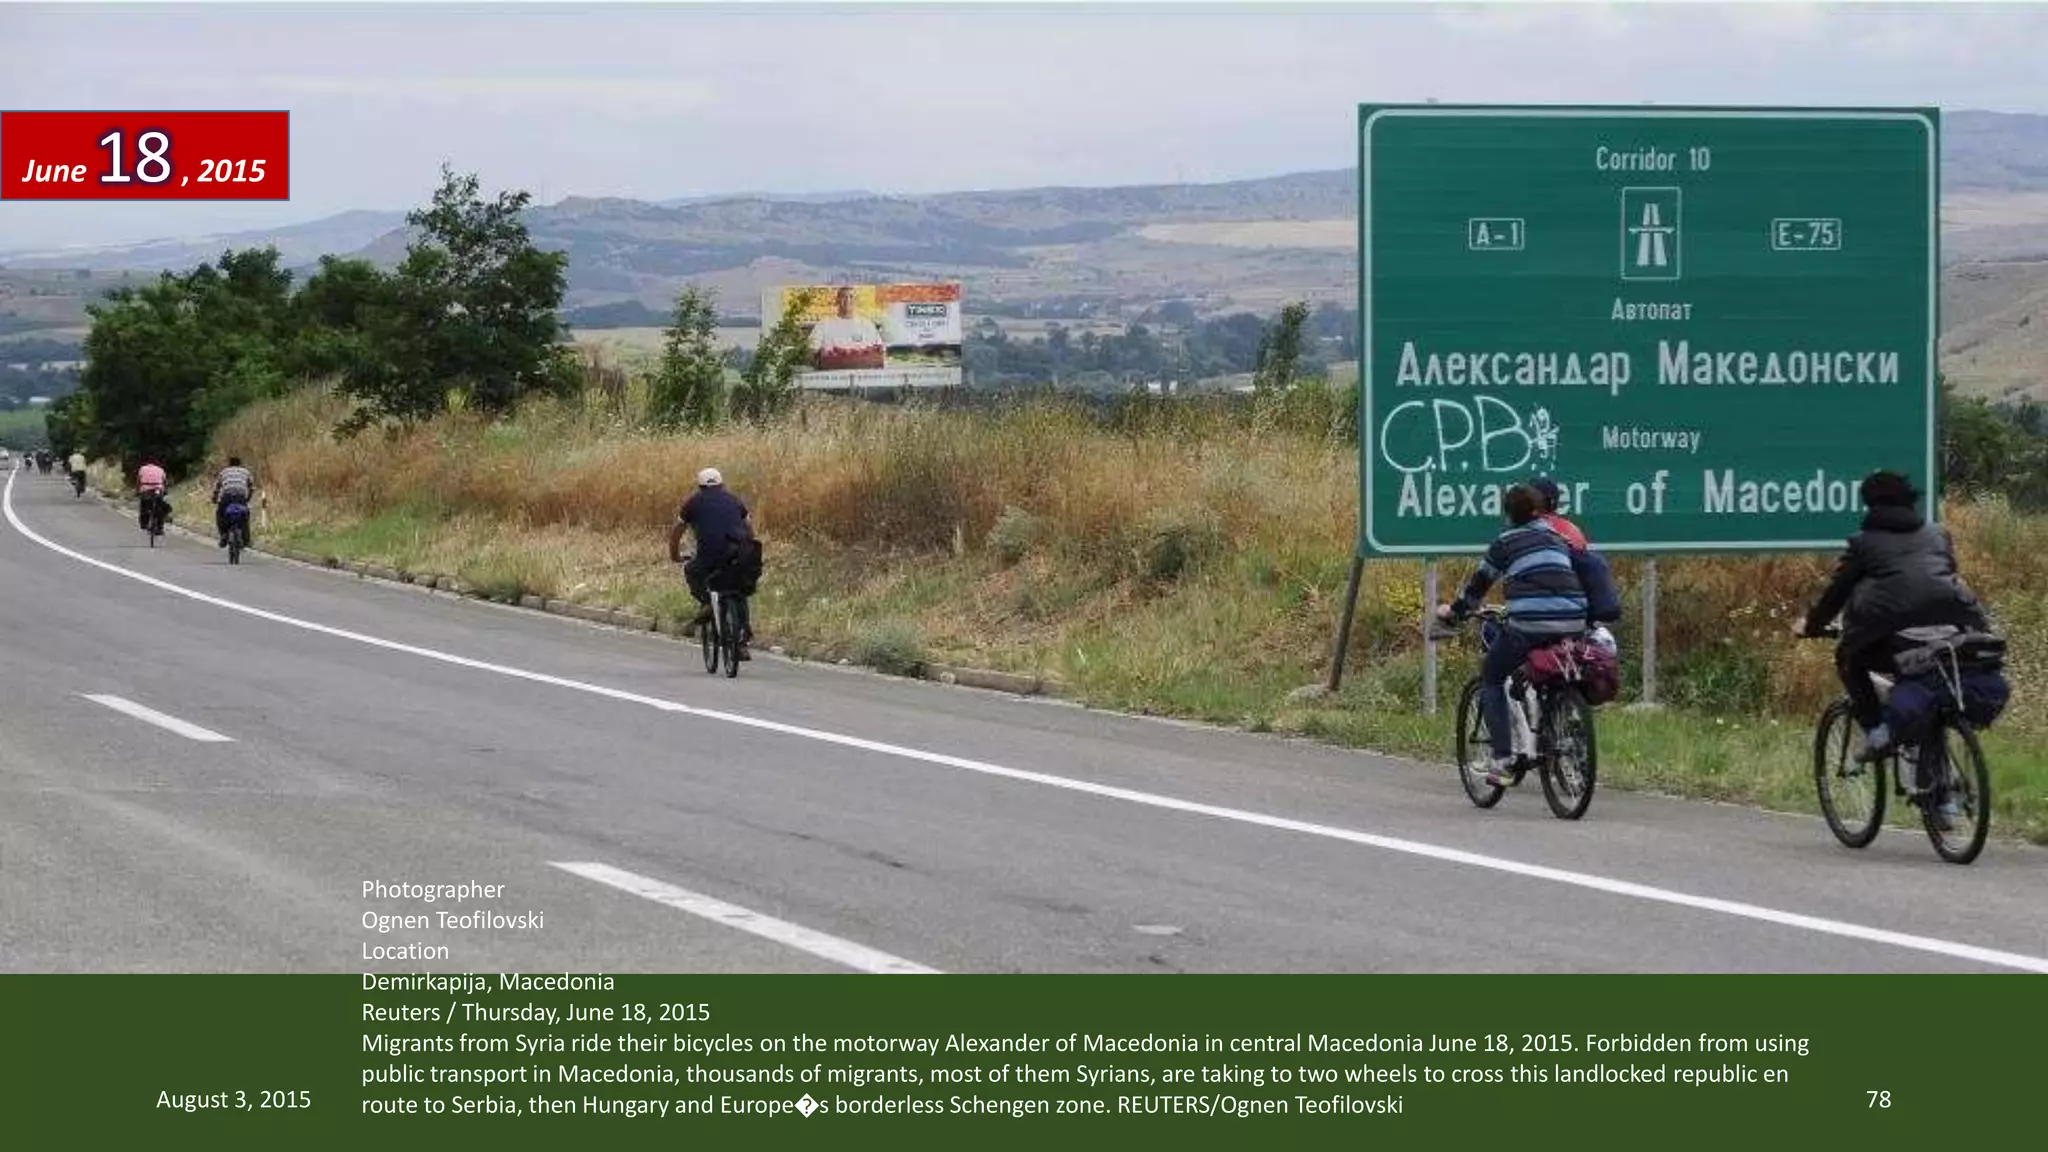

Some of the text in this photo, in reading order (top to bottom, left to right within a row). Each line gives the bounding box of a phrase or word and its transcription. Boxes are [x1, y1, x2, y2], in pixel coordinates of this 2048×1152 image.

[1596, 146, 1711, 171] Corridor 10
[1476, 223, 1518, 246] A-1
[1778, 223, 1834, 246] E-75
[1611, 297, 1693, 321] Автопат
[1397, 341, 1899, 395] Александар Македонски
[1602, 425, 1701, 454] Motorway
[1397, 472, 1590, 517] Alexaer
[1626, 469, 1670, 514] of
